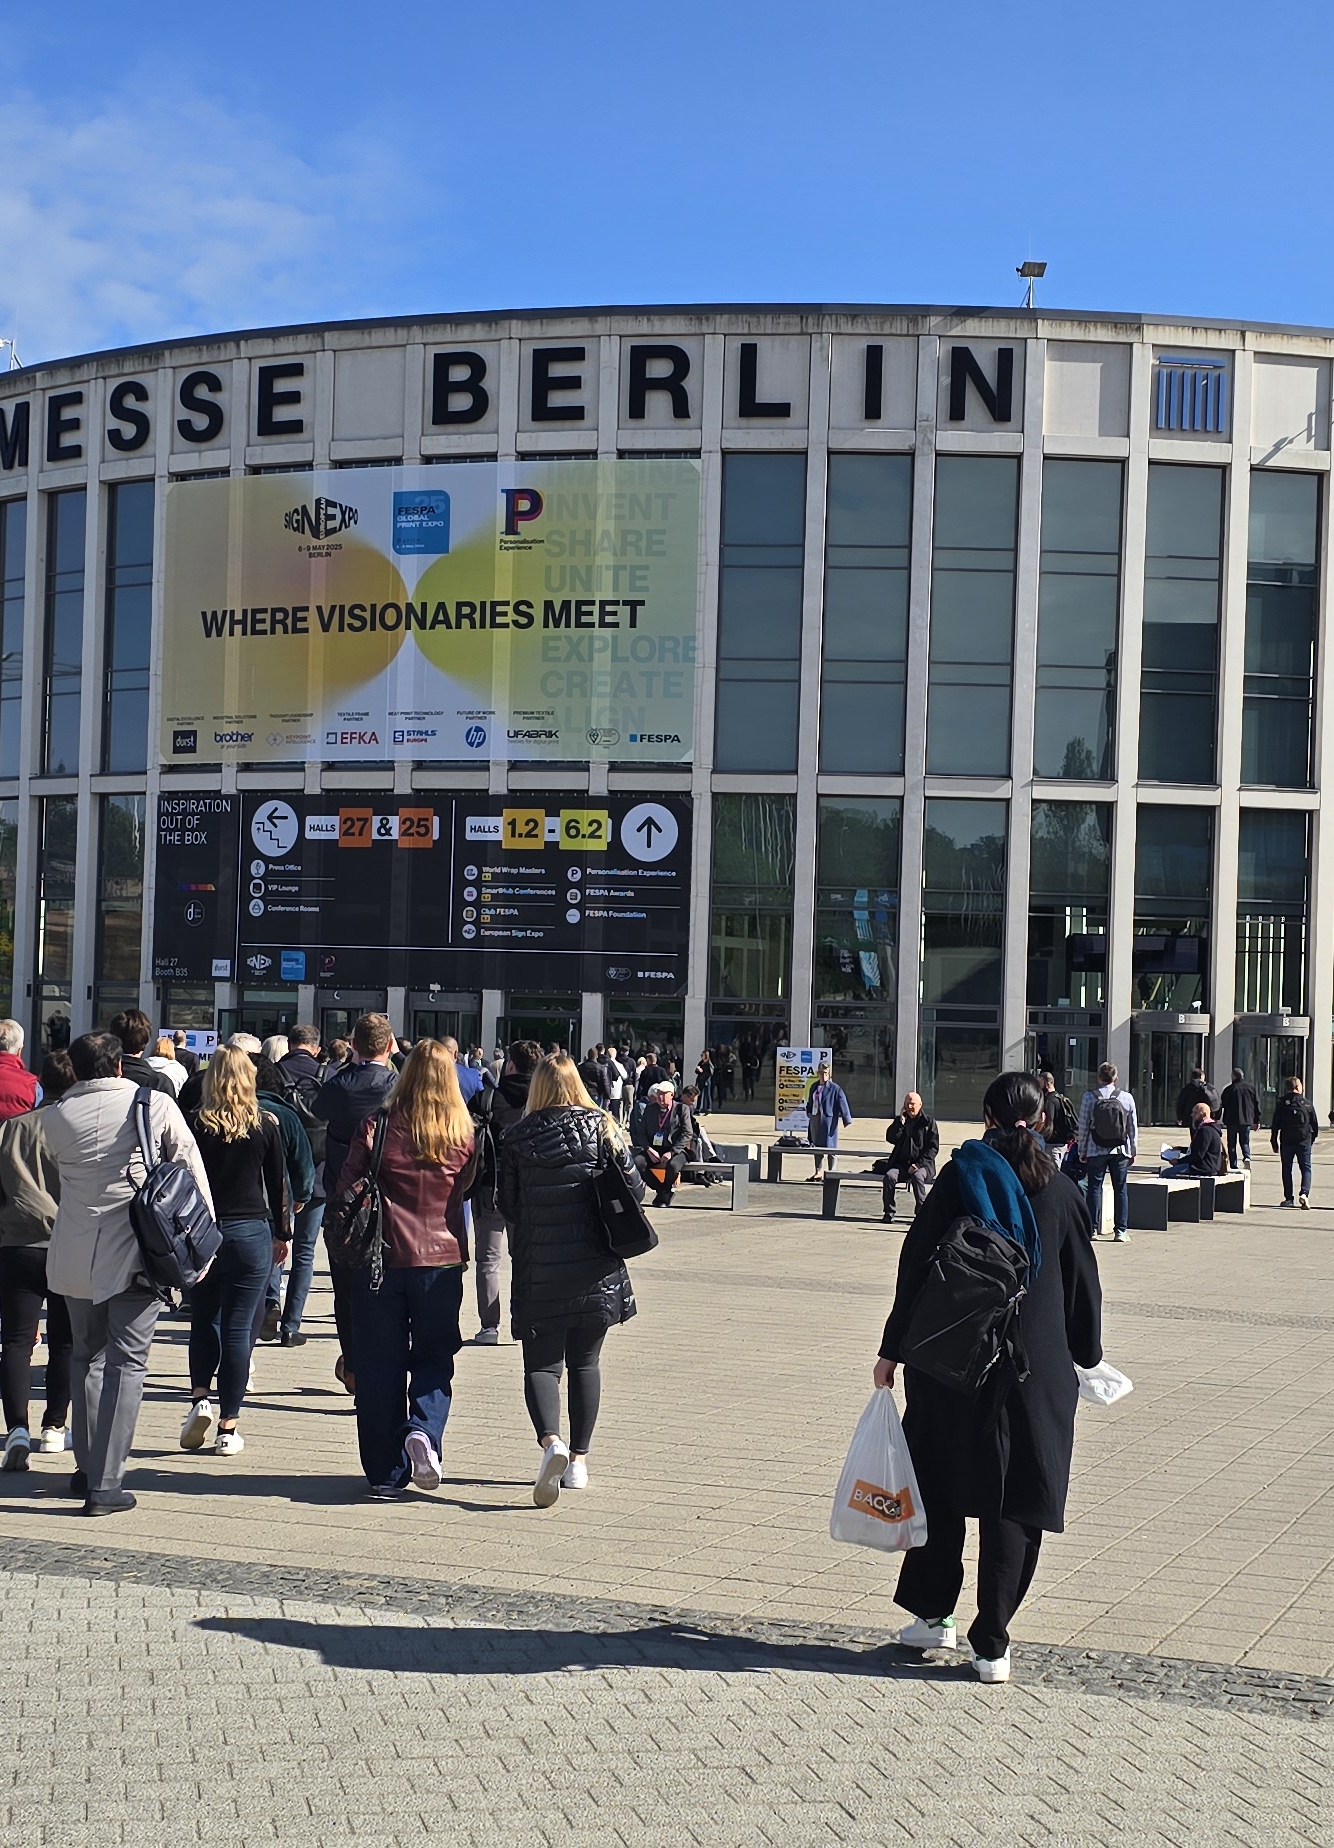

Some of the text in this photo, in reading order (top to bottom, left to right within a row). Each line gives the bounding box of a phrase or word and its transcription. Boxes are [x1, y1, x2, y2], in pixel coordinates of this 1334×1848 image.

[431, 343, 1014, 426] BERLIN
[397, 505, 436, 515] FESPA
[501, 488, 544, 536] P
[545, 492, 678, 521] INVENT
[284, 497, 359, 540] SIGN EXPO
[422, 520, 445, 528] EXPO
[325, 543, 343, 551] 2025
[499, 544, 533, 552] Experience
[544, 529, 667, 557] SHARE
[308, 551, 332, 559] BERLIN
[543, 564, 651, 593] UNITE
[201, 599, 646, 639] WHERE VISIONARIES MEET
[541, 634, 697, 664] EXPLORE
[539, 670, 684, 699] CREATE
[539, 705, 646, 734] ALIGN
[214, 731, 255, 743] brother
[340, 731, 379, 745] EFKA
[467, 727, 485, 748] hp
[507, 729, 560, 738] UFABRIK
[639, 733, 682, 743] FESPA
[175, 734, 194, 748] durst
[160, 800, 231, 813] INSPIRATION
[160, 816, 201, 829] OUT OF
[309, 816, 431, 838] HALLS 27 & 25
[469, 825, 500, 834] HALLS
[507, 817, 540, 838] 1.2
[564, 818, 603, 840] 6.2
[160, 831, 208, 845] THE BOX
[268, 863, 284, 871] Press
[501, 866, 519, 874] Wrap
[586, 867, 677, 878] Personalisation Experience
[278, 884, 299, 893] Lounge
[514, 887, 556, 896] Conferences
[585, 889, 635, 897] FESPA Awards
[267, 904, 320, 912] Conference Rooms
[496, 908, 519, 916] FESPA
[585, 909, 647, 919] FESPA Foundation
[480, 928, 544, 938] European Sign Expo
[169, 957, 179, 966] 27
[155, 968, 175, 976] Booth
[644, 971, 675, 979] FESPA
[819, 1051, 828, 1061] P
[778, 1065, 815, 1076] FESPA
